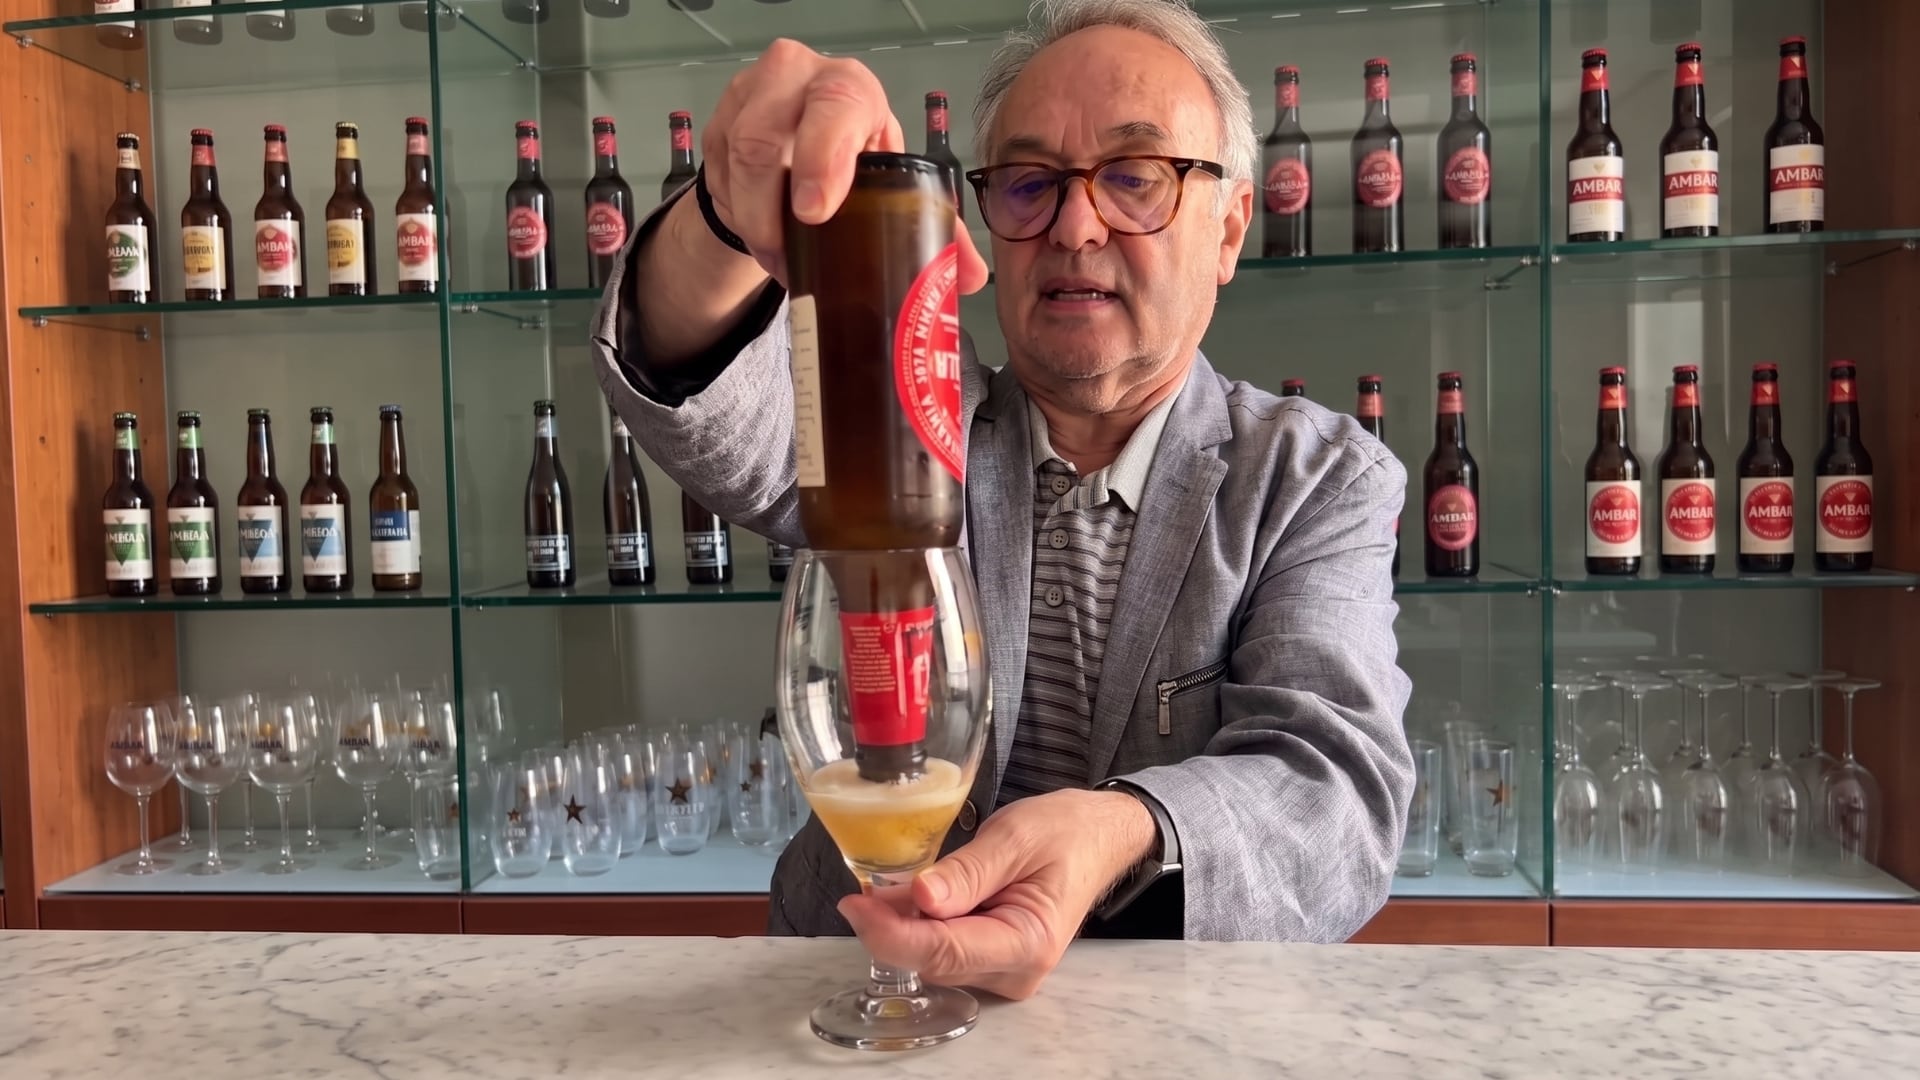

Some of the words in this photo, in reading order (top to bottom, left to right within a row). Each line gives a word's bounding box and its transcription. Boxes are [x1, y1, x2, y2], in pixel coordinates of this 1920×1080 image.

[1668, 174, 1718, 190] AMBAR
[1775, 167, 1824, 185] AMBAR
[1573, 179, 1622, 195] AMBAR
[1593, 508, 1637, 521] AMBAR
[1670, 506, 1714, 519] AMBAR
[1748, 505, 1793, 518] AMBAR
[1823, 503, 1870, 517] AMBAR
[1431, 512, 1474, 523] AMBAR
